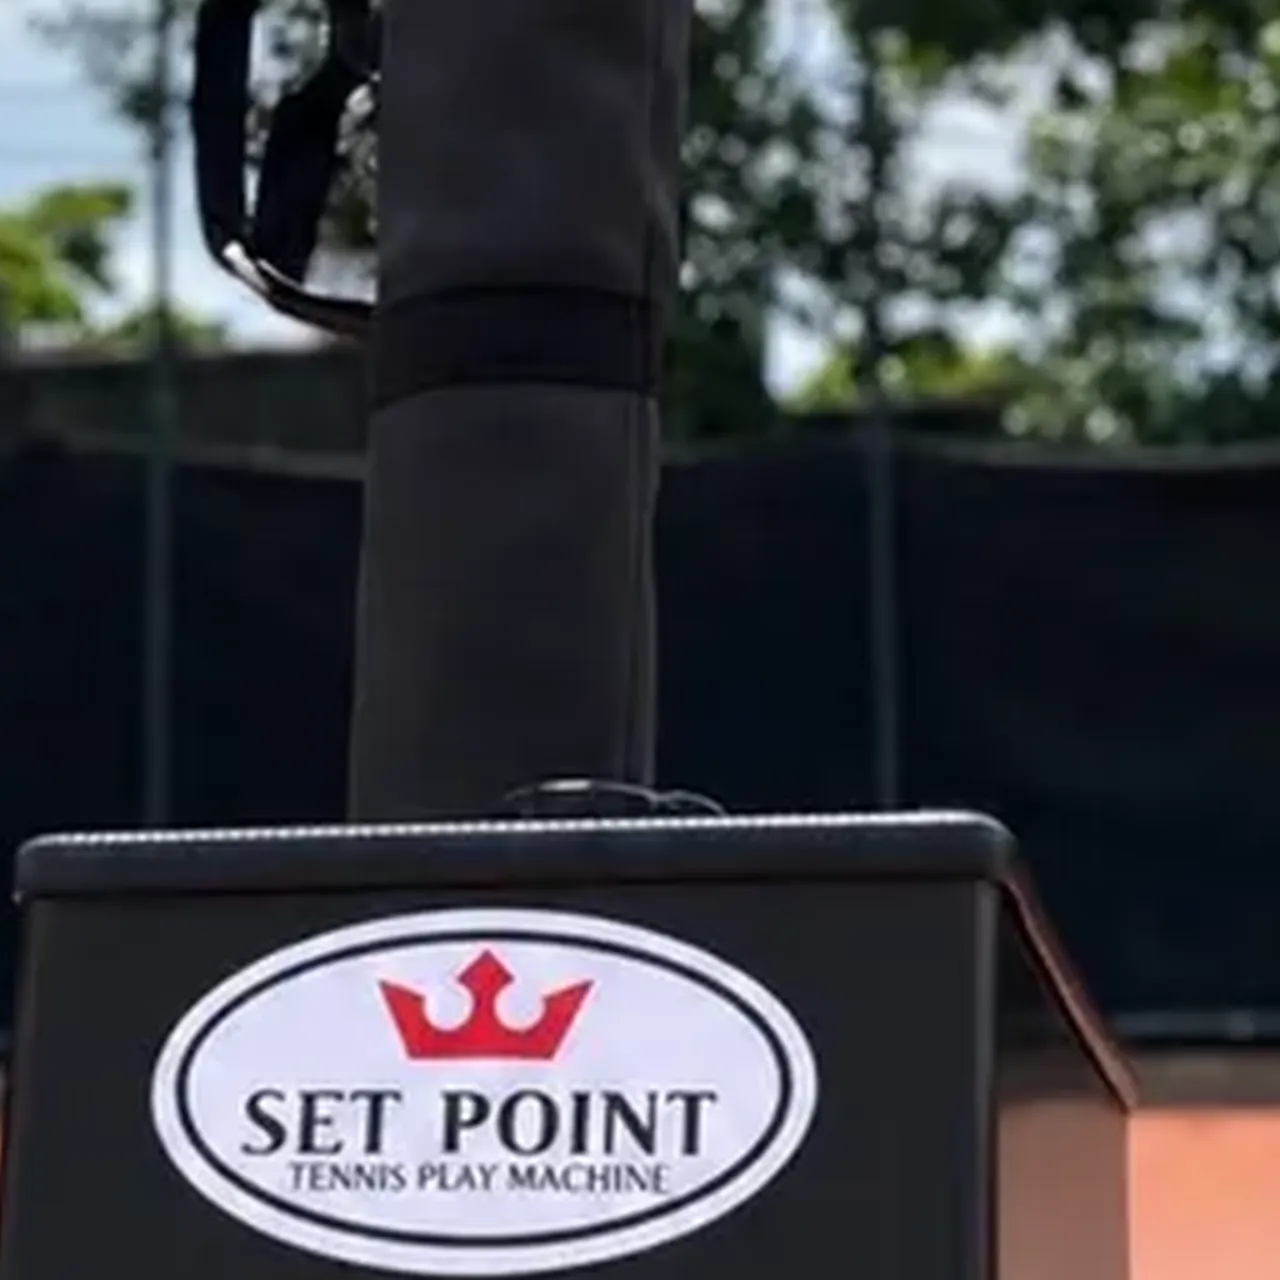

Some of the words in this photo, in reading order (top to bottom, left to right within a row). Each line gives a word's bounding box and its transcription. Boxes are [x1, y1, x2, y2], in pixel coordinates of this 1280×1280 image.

[241, 1090, 403, 1156] SET
[441, 1090, 718, 1157] POINT
[290, 1162, 407, 1191] TENNIS
[420, 1163, 499, 1192] PLAY
[507, 1163, 671, 1194] MACHINE
